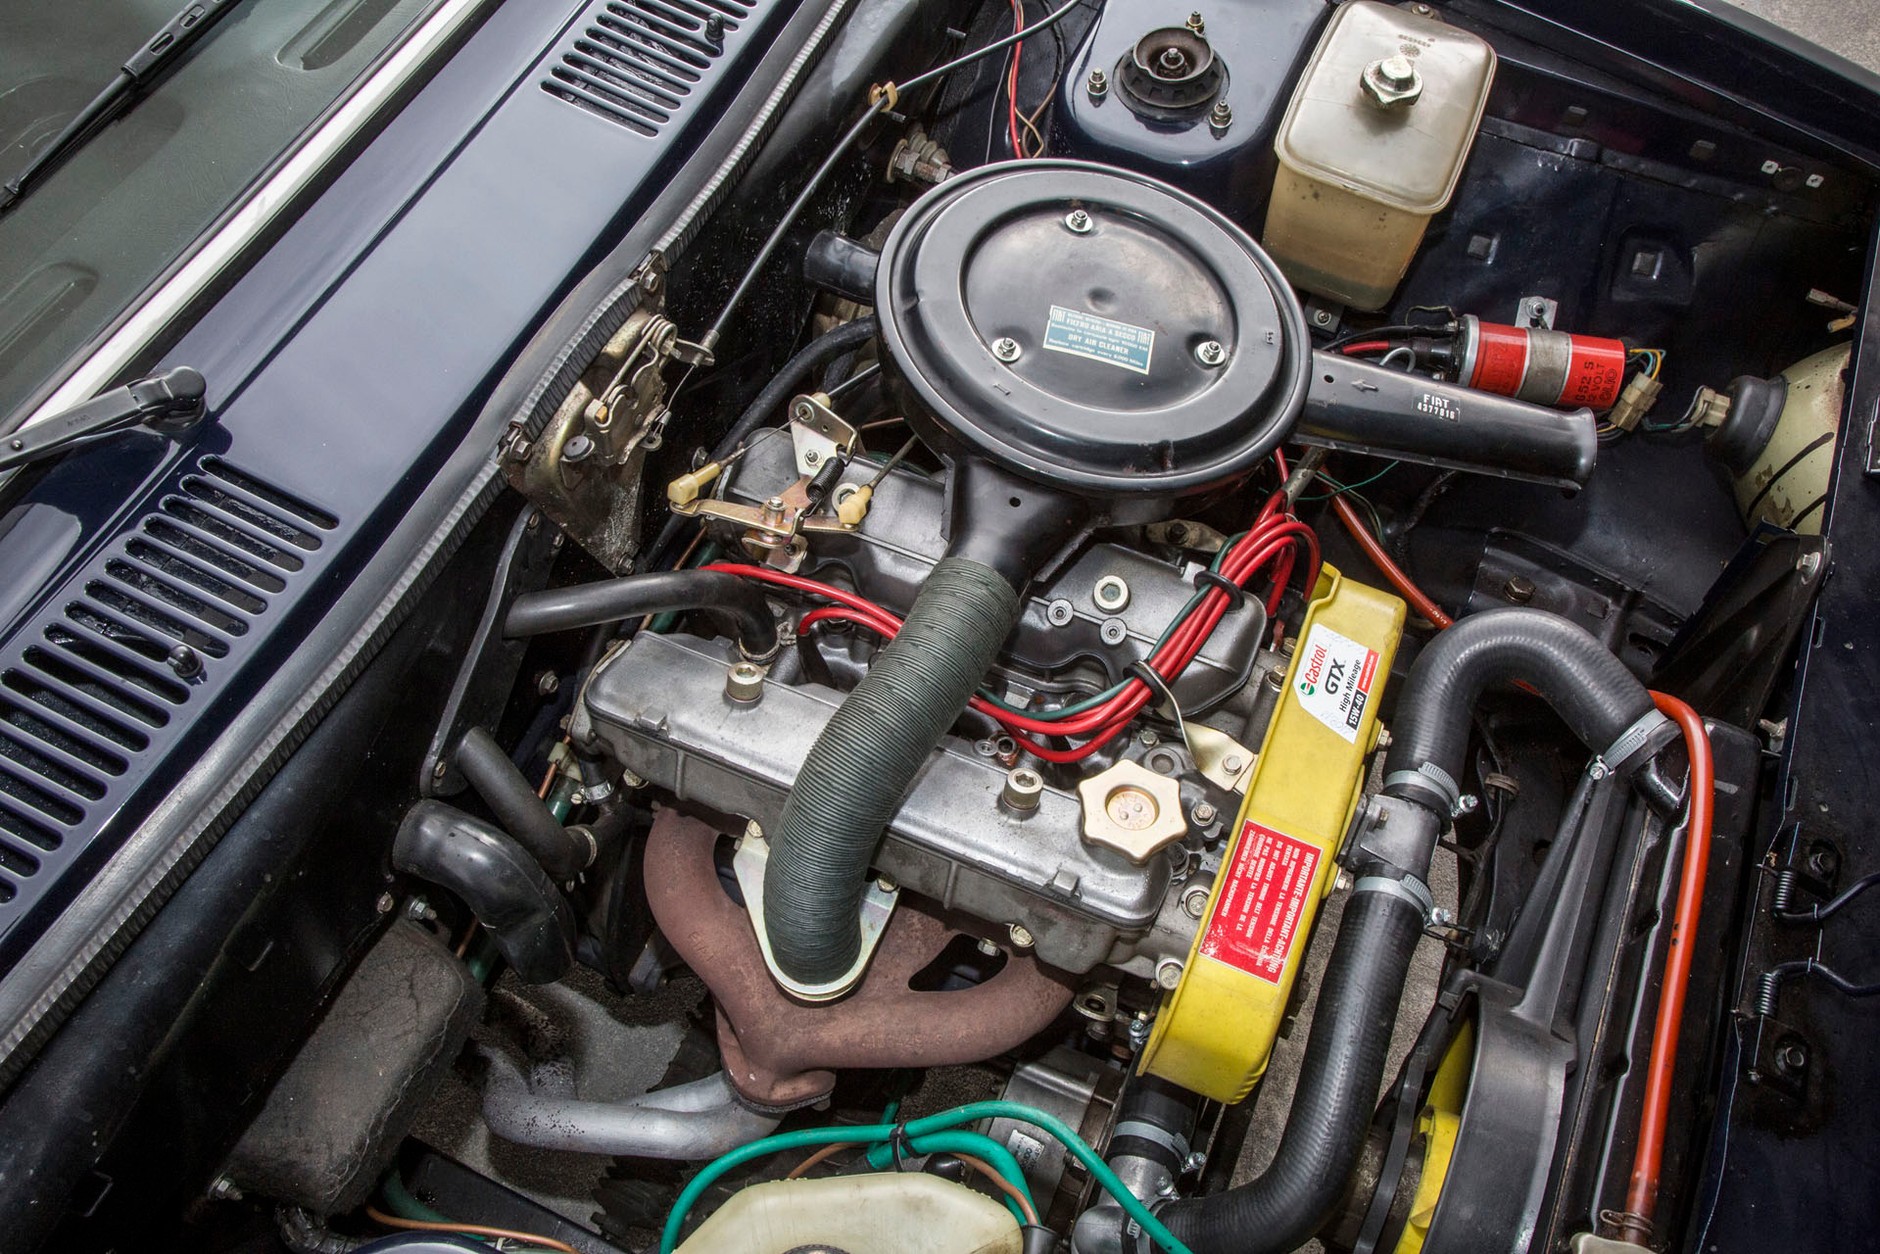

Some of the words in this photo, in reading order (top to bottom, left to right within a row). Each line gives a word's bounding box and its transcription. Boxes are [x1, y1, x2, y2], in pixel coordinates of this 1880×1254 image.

[1090, 323, 1106, 333] ARIA
[1115, 330, 1136, 341] SECCO
[1067, 333, 1081, 342] DRY
[1084, 337, 1096, 346] AIR
[1098, 341, 1128, 354] CLEANER
[1591, 363, 1605, 391] VOLT
[1423, 394, 1450, 408] FIAT
[1305, 644, 1327, 684] Castrol
[1325, 658, 1346, 695] GTX
[1339, 692, 1351, 712] High
[1346, 659, 1361, 692] Mileage
[1348, 694, 1364, 726] 15W-40
[1261, 845, 1269, 856] PAS
[1276, 840, 1283, 849] DO
[1272, 849, 1280, 860] NOT
[1264, 861, 1276, 881] ADJUST
[1278, 891, 1285, 900] LA
[1238, 913, 1246, 922] DE
[1235, 923, 1243, 931] LA
[1263, 926, 1273, 943] DELLA
